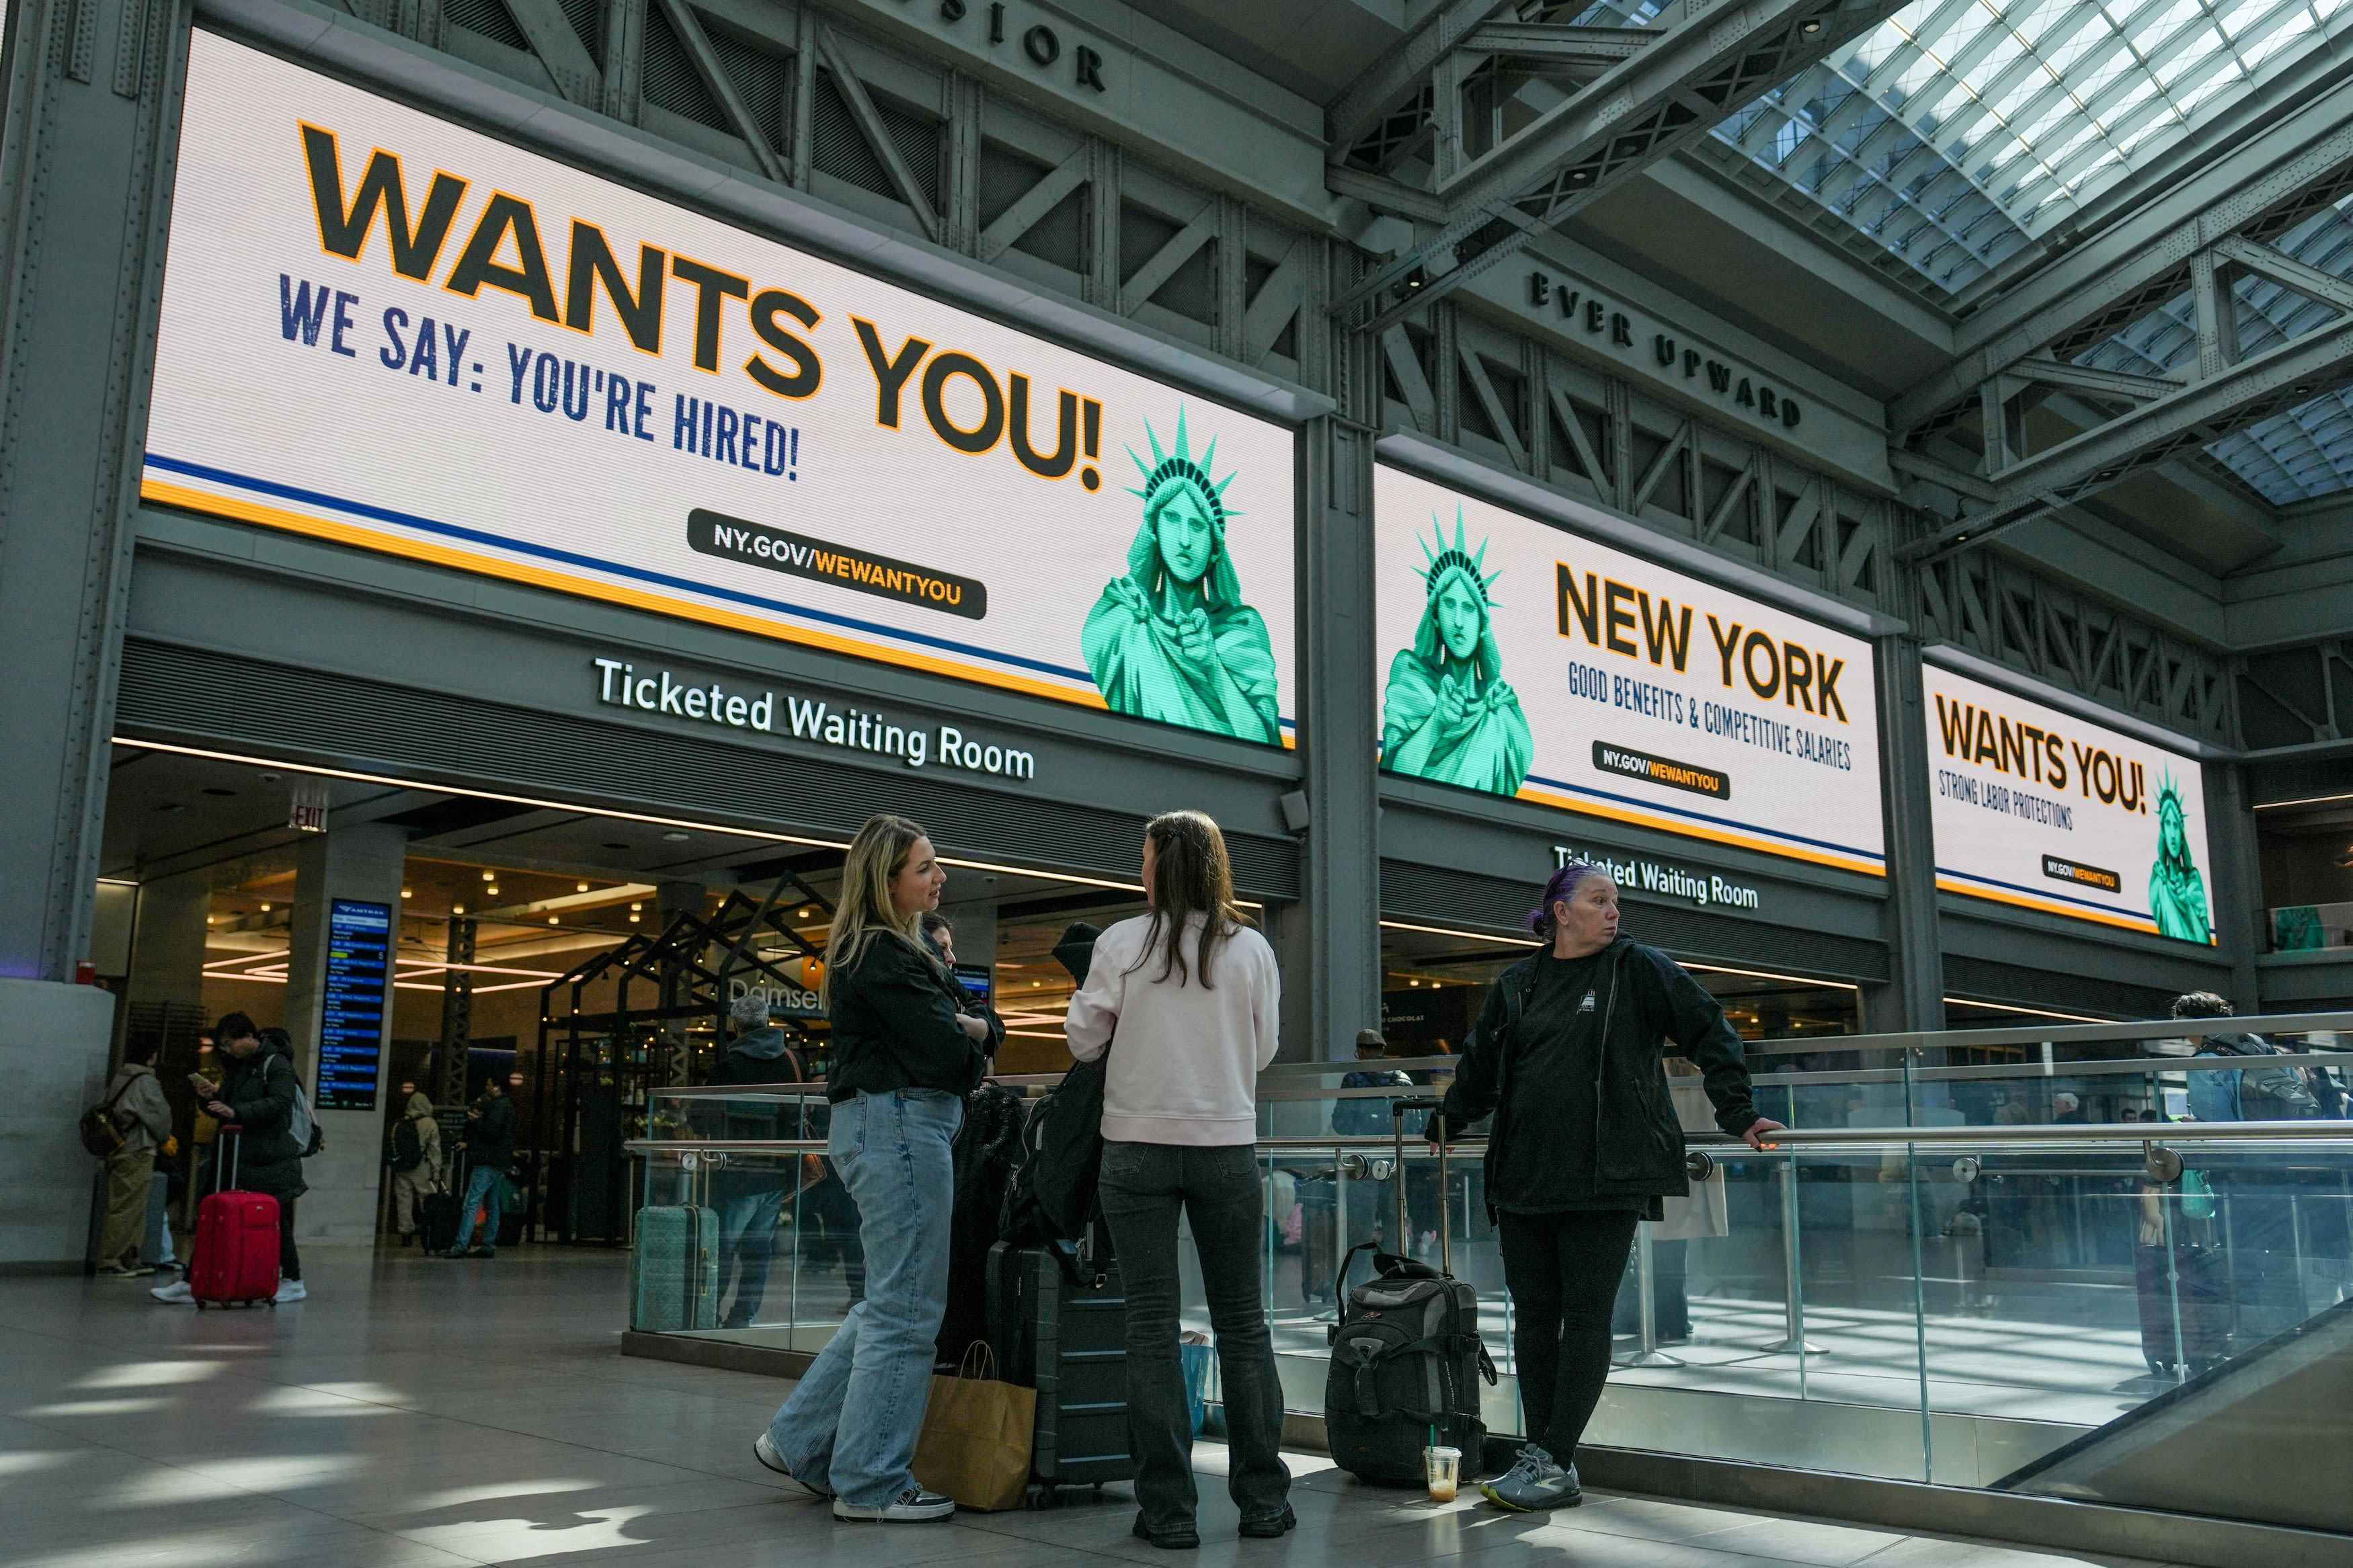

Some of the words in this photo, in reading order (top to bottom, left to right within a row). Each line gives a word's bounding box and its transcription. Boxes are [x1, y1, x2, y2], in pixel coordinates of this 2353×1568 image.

[296, 118, 825, 402] WANTS
[847, 313, 1103, 494] YOU!
[1531, 271, 1634, 347] EVER
[1656, 333, 1801, 428] UPWARD
[279, 273, 359, 358] WE
[379, 306, 483, 394] SAY:
[508, 341, 656, 444] YOU'RE
[673, 394, 800, 483] HIRED!
[714, 524, 961, 606] NY.GOV/WEWANTYOU
[1555, 560, 1693, 674] NEW
[1705, 612, 1849, 725] YORK
[594, 657, 772, 731] Ticketed
[788, 696, 927, 767] Waiting
[941, 726, 1034, 780] Room
[1568, 661, 1607, 703] GOOD
[1614, 677, 1682, 725] BENEFITS
[1689, 697, 1699, 729] &
[1705, 703, 1792, 755] COMPETITIVE
[1796, 729, 1851, 772] SALARIES
[1603, 749, 1718, 792] NY.GOV/WEWANTYOU
[1936, 692, 2067, 790] WANTS
[2071, 739, 2147, 817] YOU!
[296, 805, 323, 828] EXIT
[1939, 769, 1977, 805] STRONG
[1981, 780, 2010, 814] LABOR
[2013, 790, 2073, 831] PROTECTIONS
[1554, 845, 1636, 887] Tited
[1640, 862, 1707, 905] Waiting
[1712, 876, 1758, 909] Room
[730, 979, 823, 1010] Damsel
